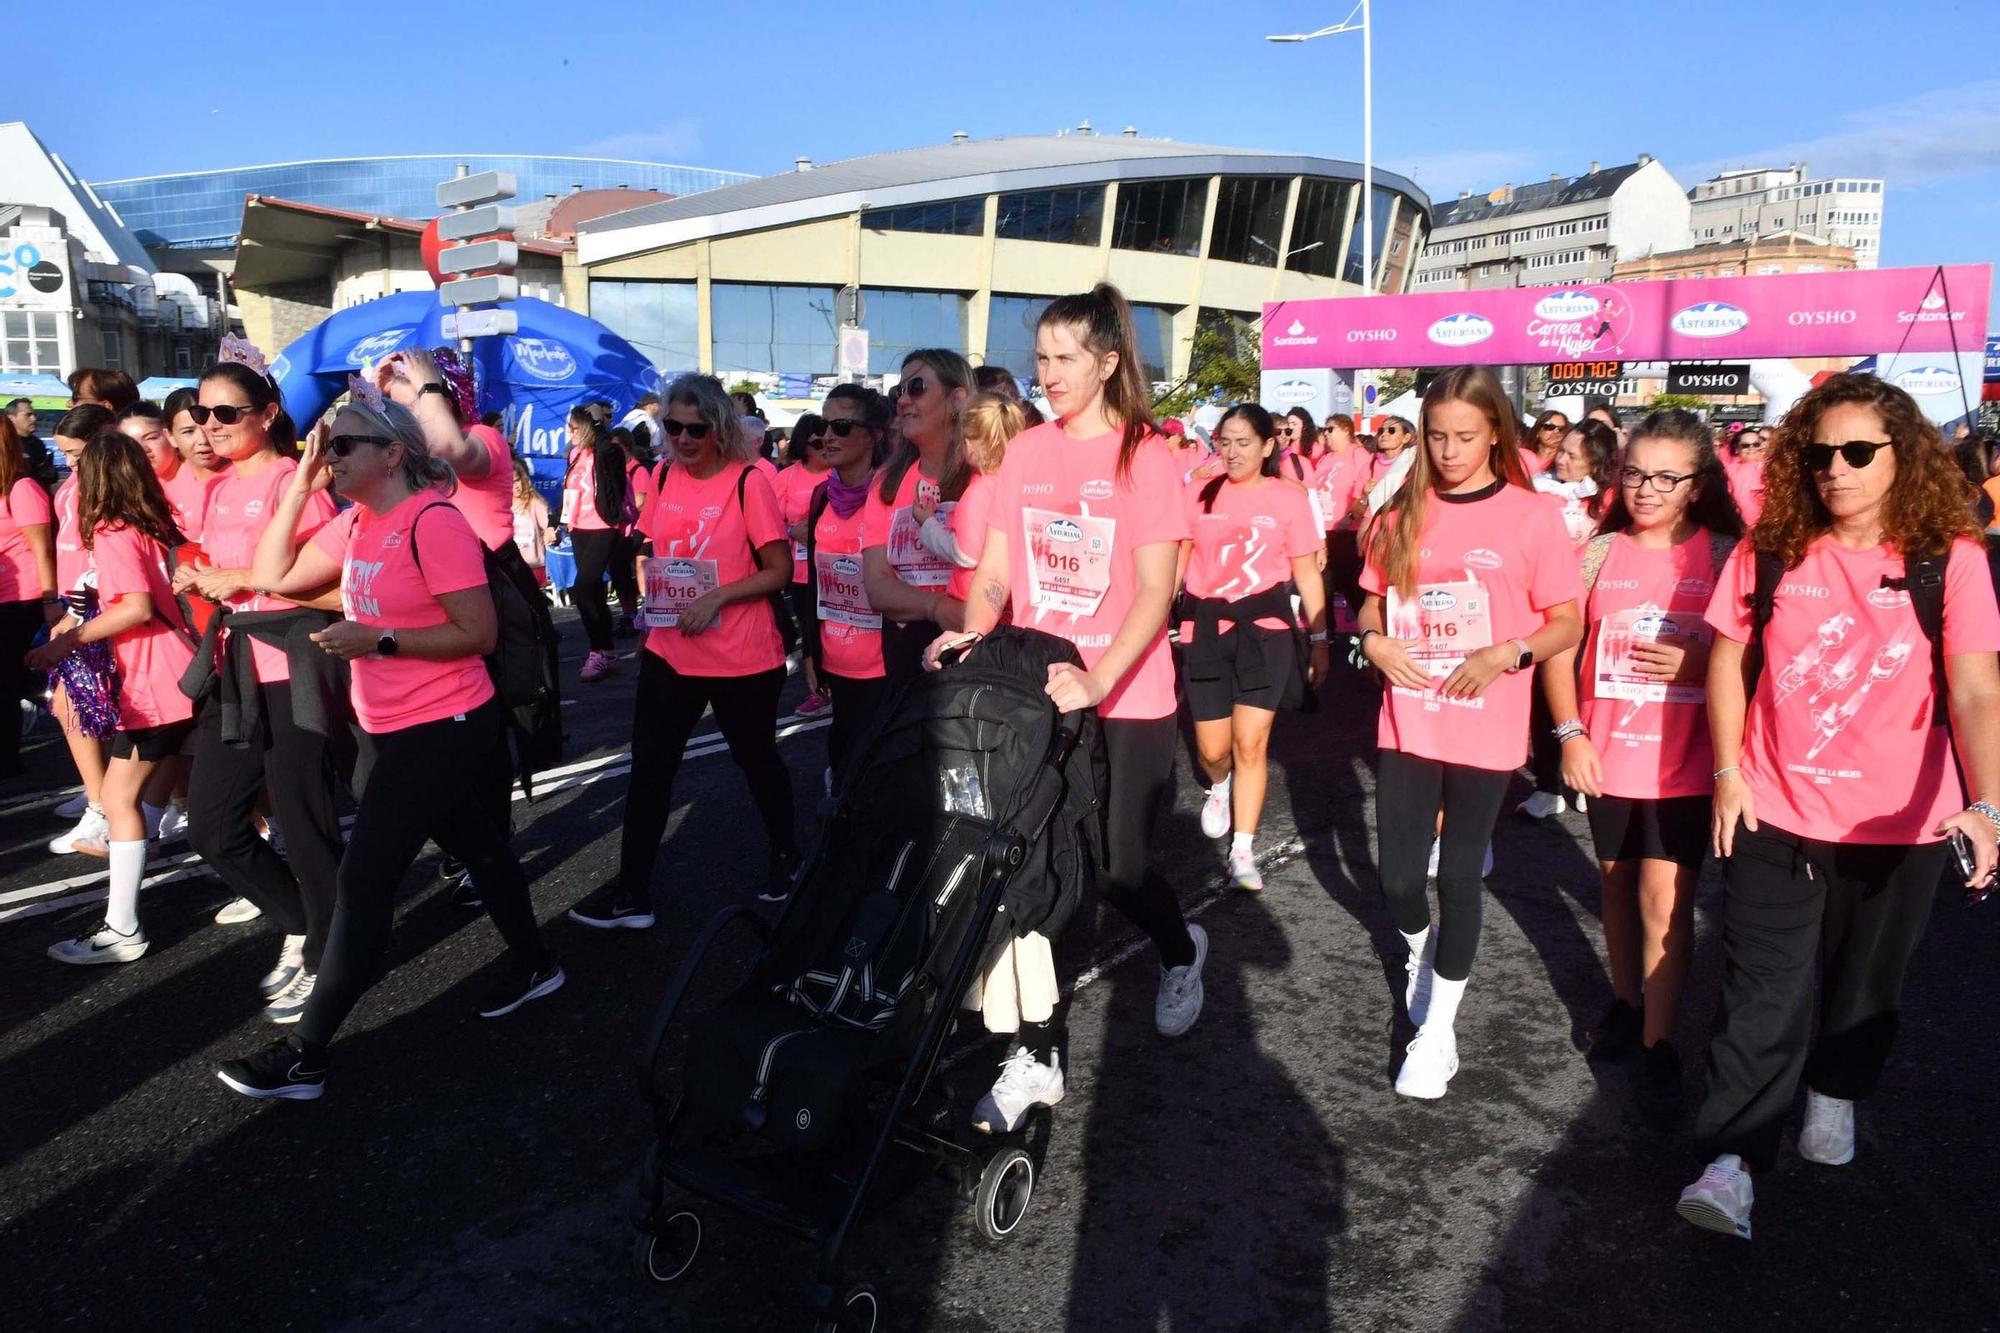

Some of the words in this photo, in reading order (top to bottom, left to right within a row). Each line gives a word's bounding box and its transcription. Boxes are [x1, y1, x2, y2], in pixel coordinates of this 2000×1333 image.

[1541, 303, 1595, 314] ASTURIANA
[1677, 316, 1743, 330] ASTURIANA
[1788, 310, 1856, 325] OYSHO
[1897, 311, 1966, 322] Santander
[1347, 328, 1397, 342] OYSHO
[1436, 325, 1489, 338] ASTURIANA
[1526, 320, 1582, 336] Carrera
[1273, 336, 1319, 346] Santander
[1556, 333, 1598, 359] Mujer
[1678, 373, 1739, 387] OYSHO
[1899, 376, 1959, 389] ASTURIANA
[1548, 382, 1618, 396] OYSHO
[1048, 526, 1081, 540] ASTURIANA
[667, 565, 697, 574] ASTURIANA
[1048, 553, 1080, 573] 016
[668, 586, 697, 598] 016
[836, 583, 860, 597] 016
[1597, 580, 1639, 591] OYSHO
[1424, 622, 1458, 638] 016
